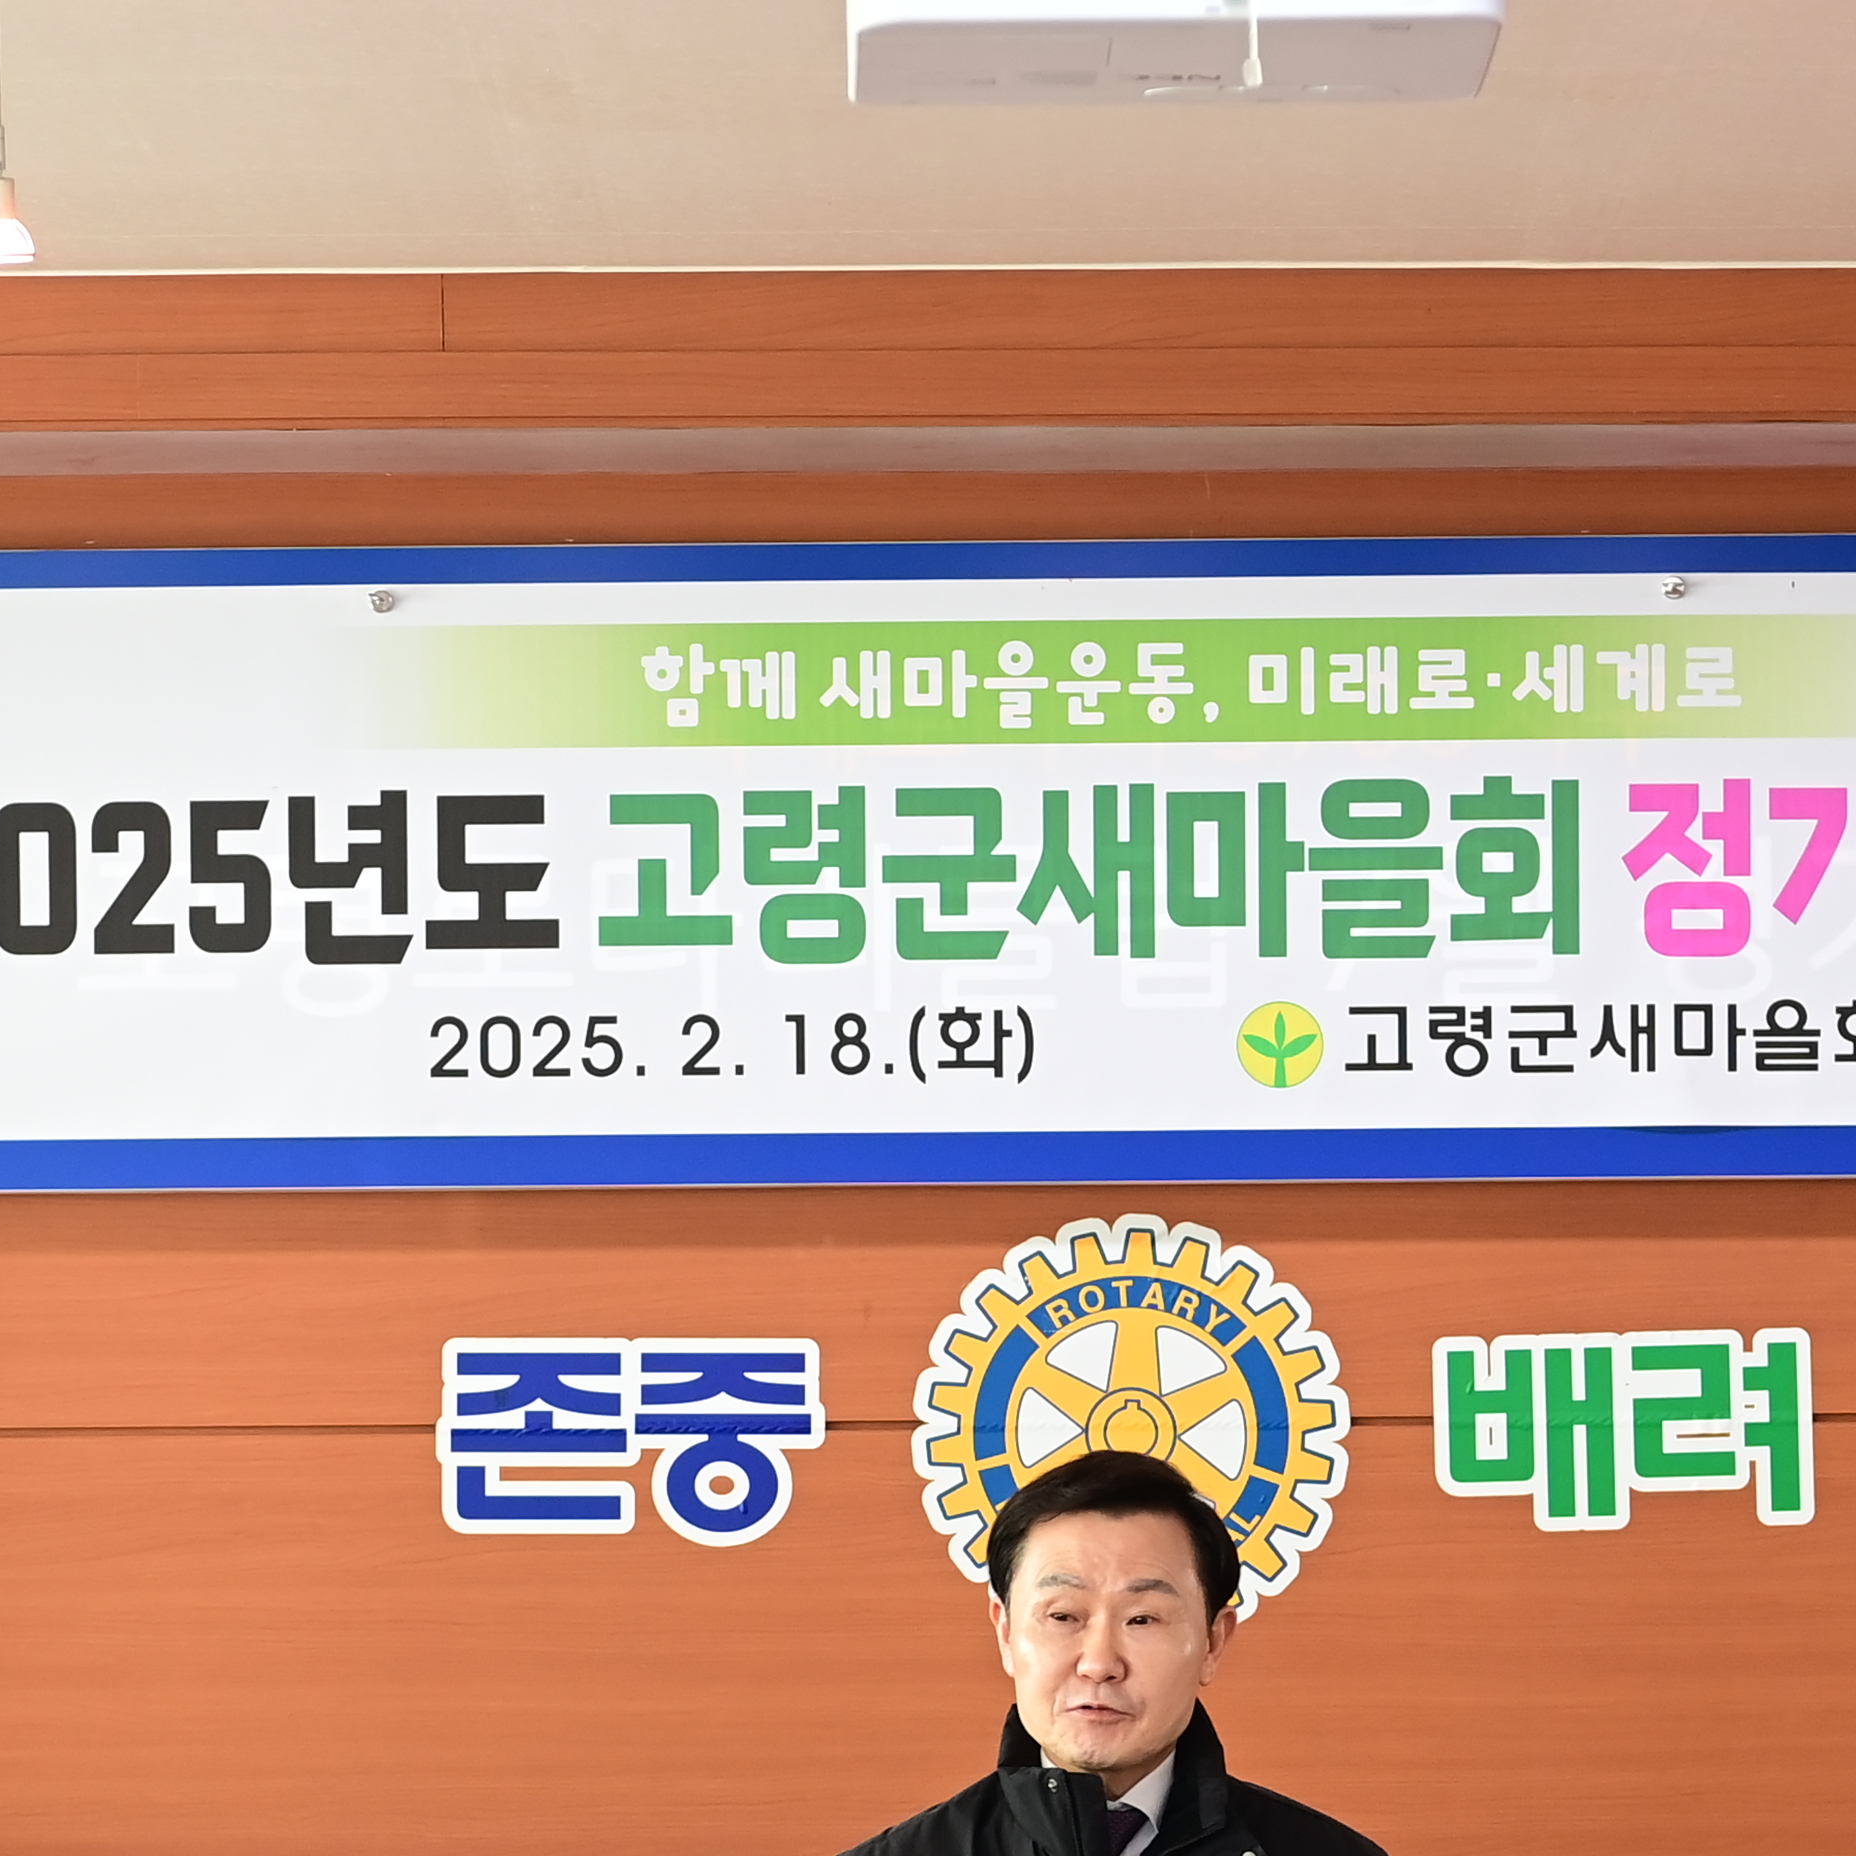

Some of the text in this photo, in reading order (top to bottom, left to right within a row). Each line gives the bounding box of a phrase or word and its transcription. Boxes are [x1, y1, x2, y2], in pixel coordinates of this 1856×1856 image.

[641, 640, 1742, 729] 함께 새마을운동, 미래로·세계로
[599, 777, 1580, 965] 고령군새마을회
[429, 1005, 1035, 1084] 2025. 2. 18.(화)
[1045, 1279, 1231, 1334] ROTARY
[452, 1353, 812, 1532] 존중
[1446, 1341, 1802, 1518] 배려
